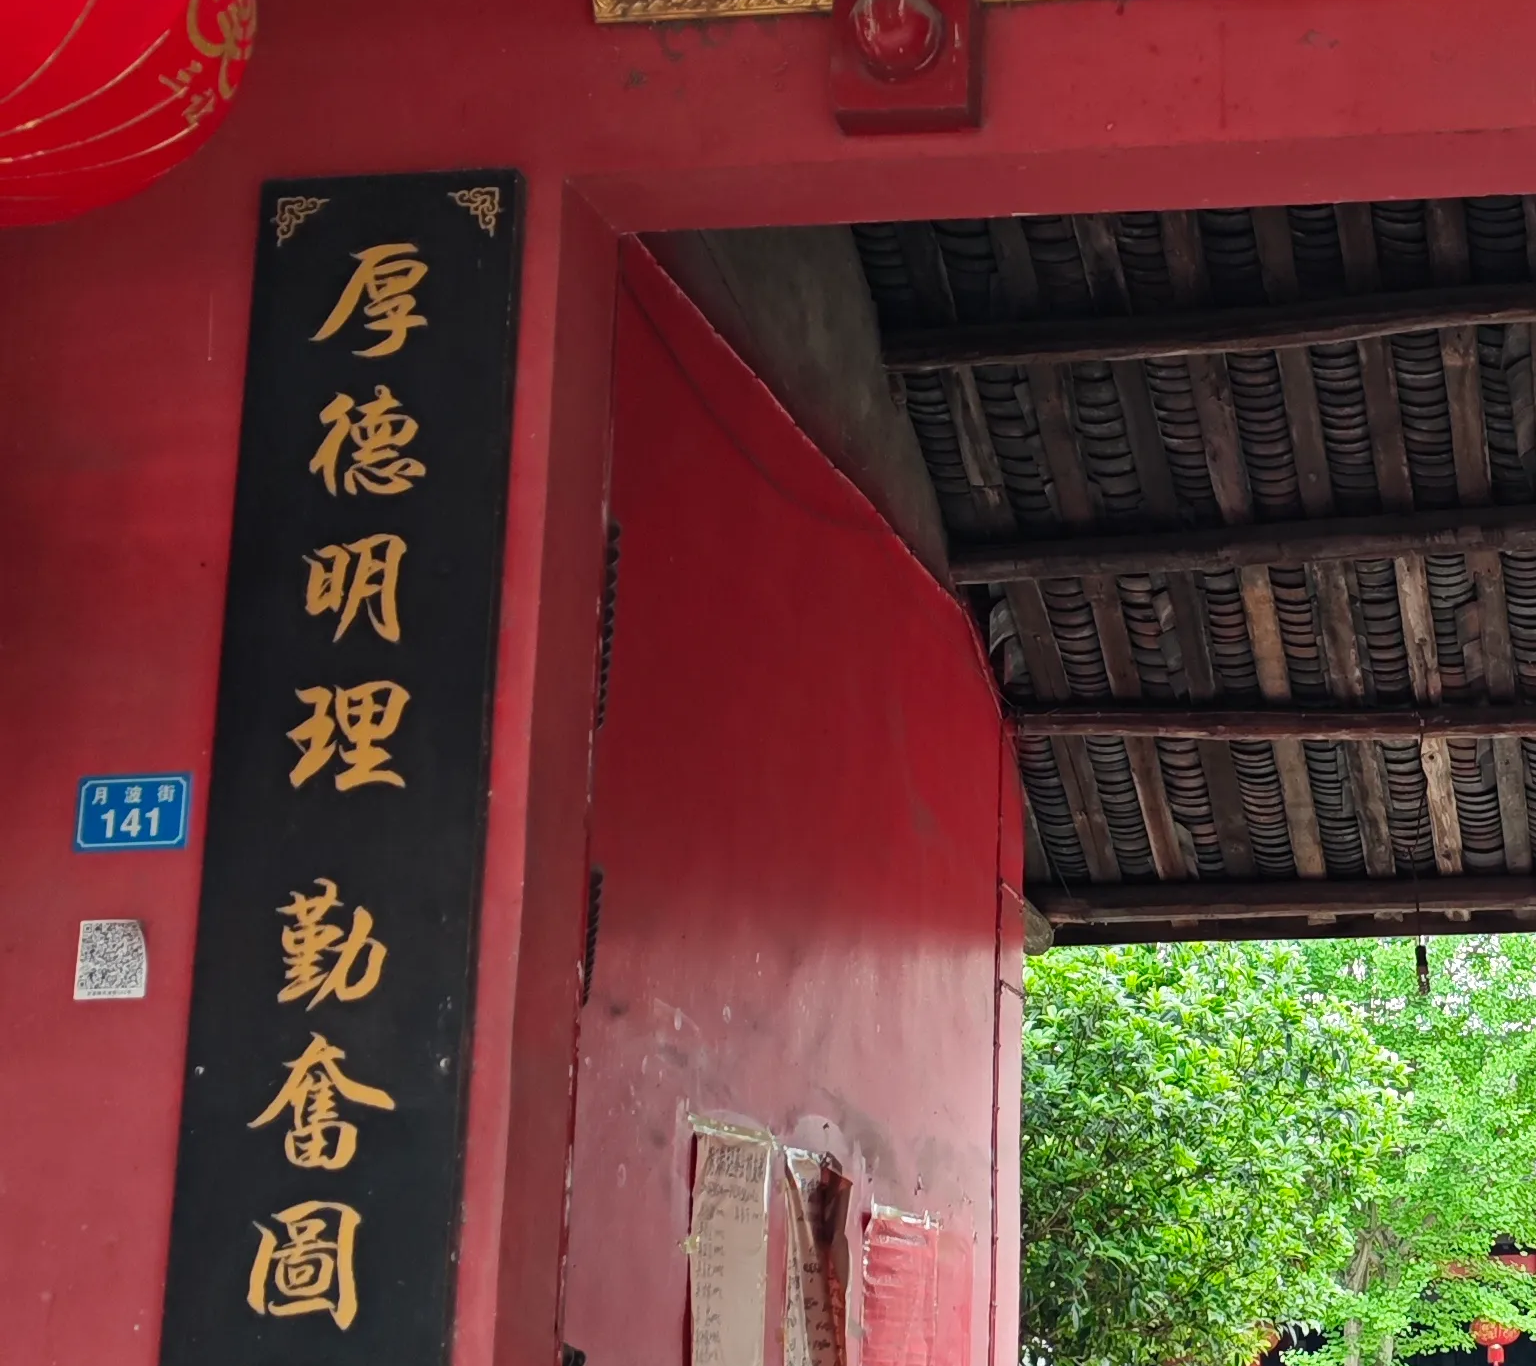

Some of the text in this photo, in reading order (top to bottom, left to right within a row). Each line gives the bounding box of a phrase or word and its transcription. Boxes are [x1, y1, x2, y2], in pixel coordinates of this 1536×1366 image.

[92, 784, 176, 805] 月波街
[101, 807, 160, 838] 141
